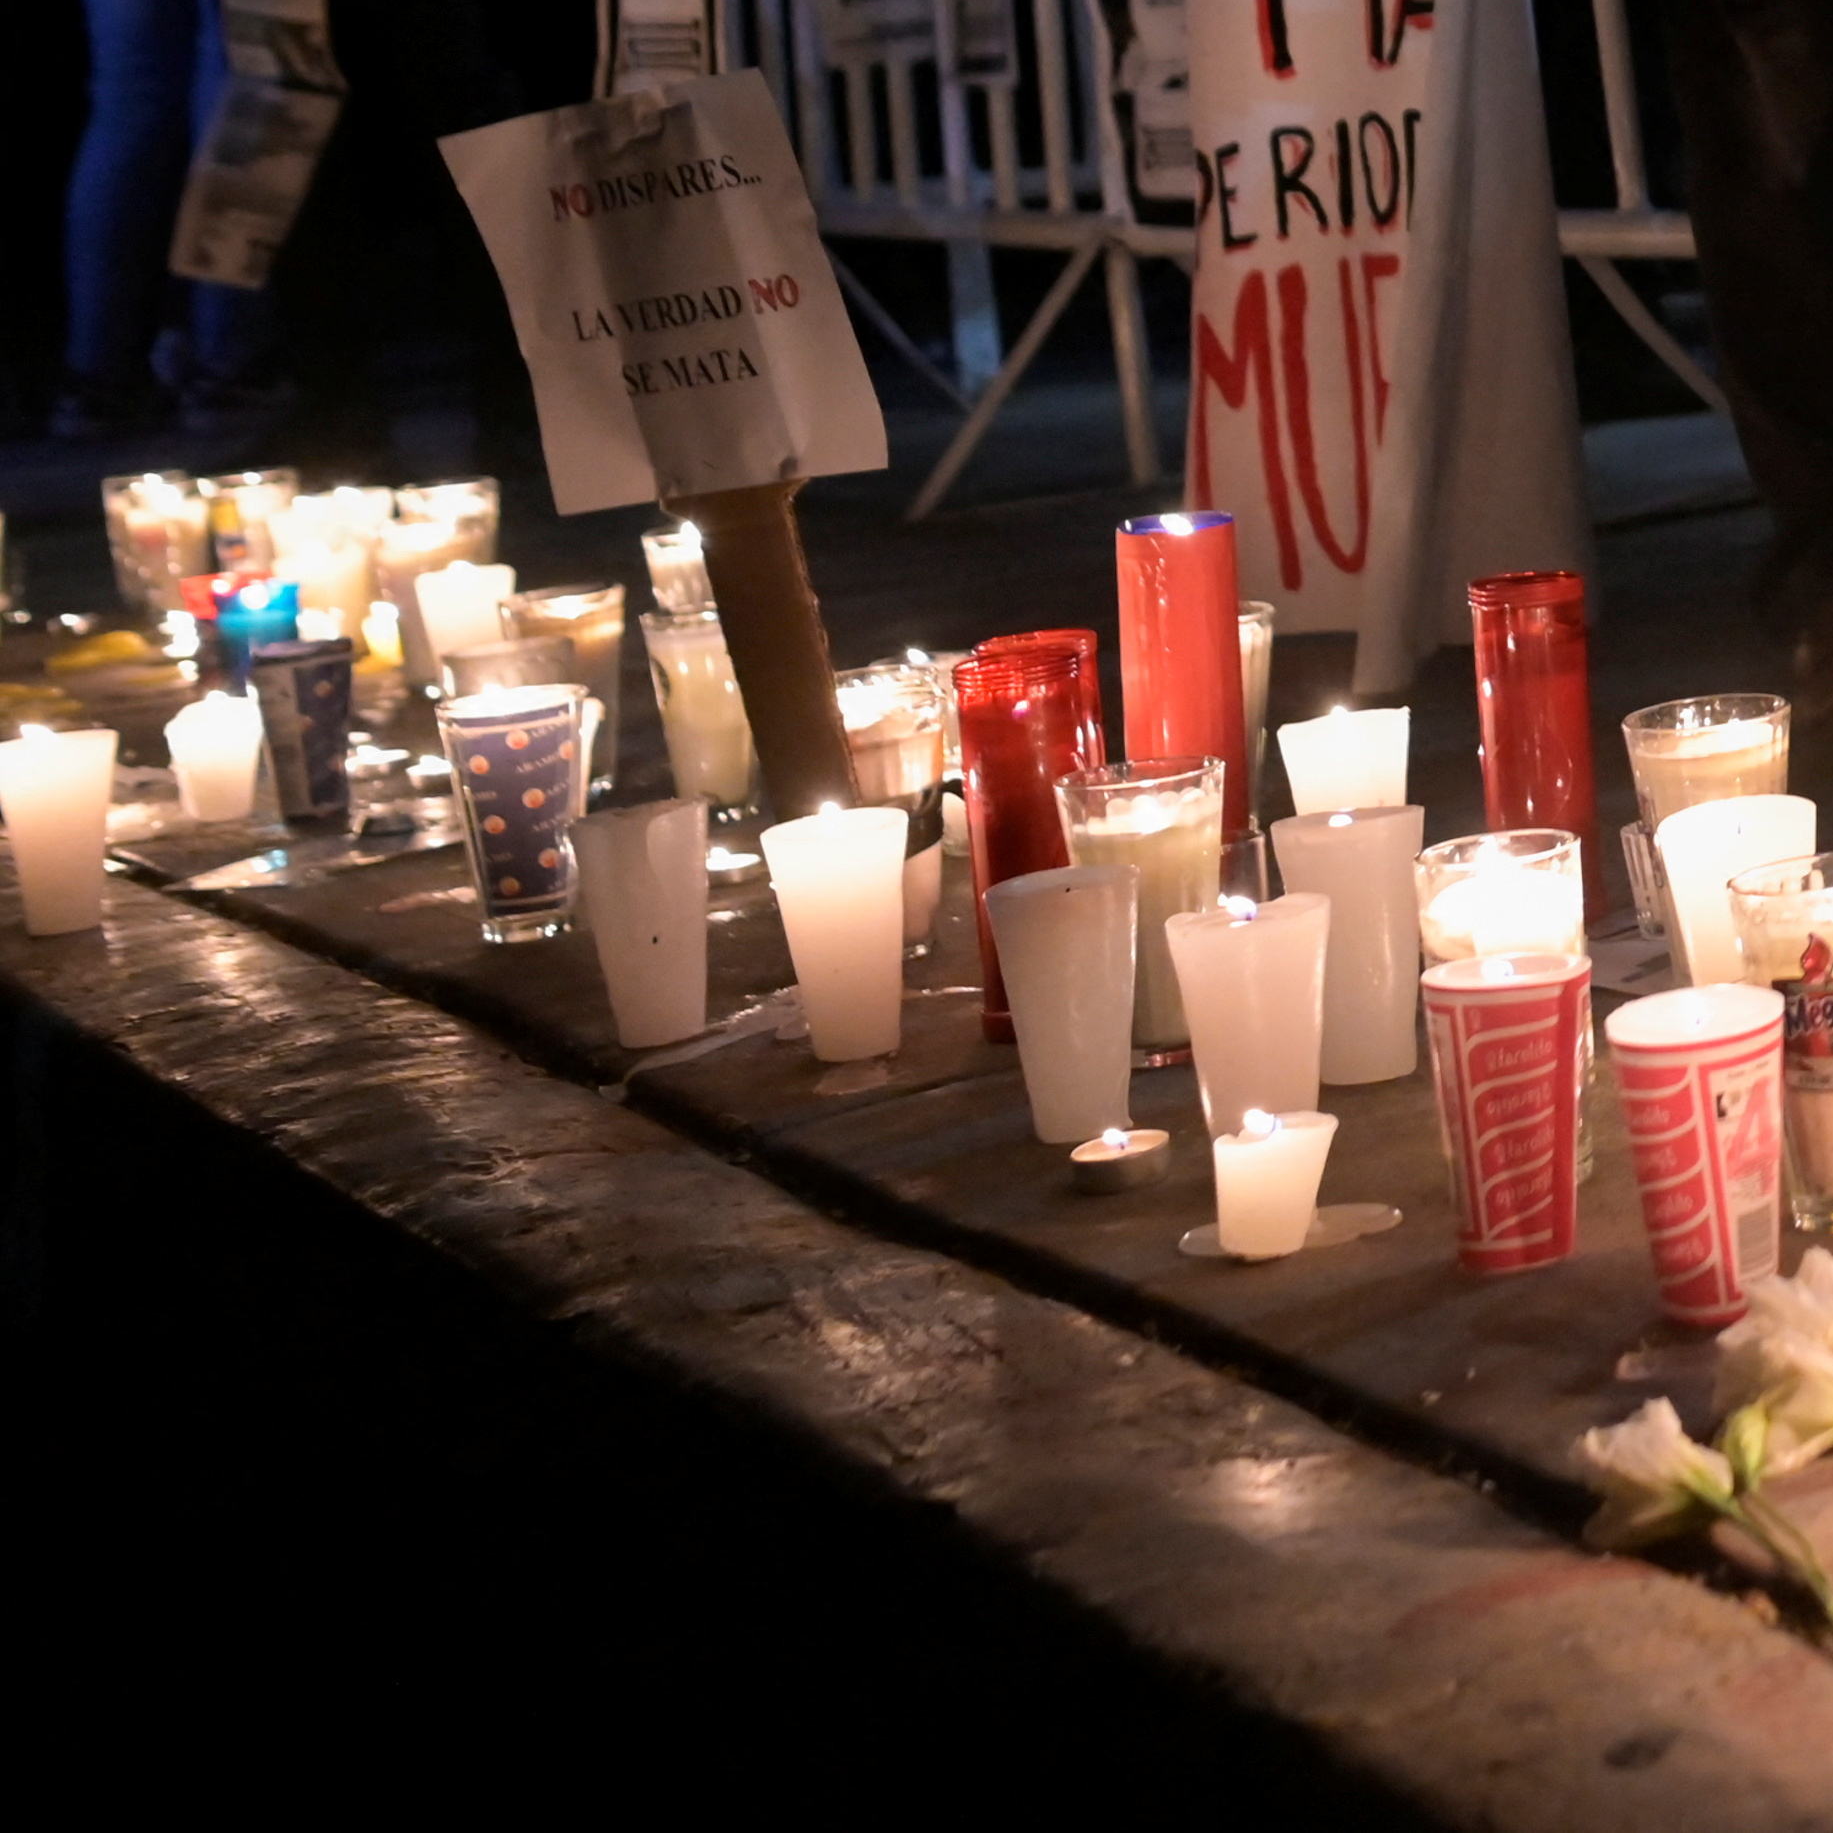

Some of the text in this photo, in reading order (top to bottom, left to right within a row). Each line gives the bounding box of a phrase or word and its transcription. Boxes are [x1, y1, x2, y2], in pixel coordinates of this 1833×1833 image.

[549, 182, 595, 222] NO
[572, 273, 799, 342] LA VERDAD NO
[622, 347, 760, 398] SE MATA
